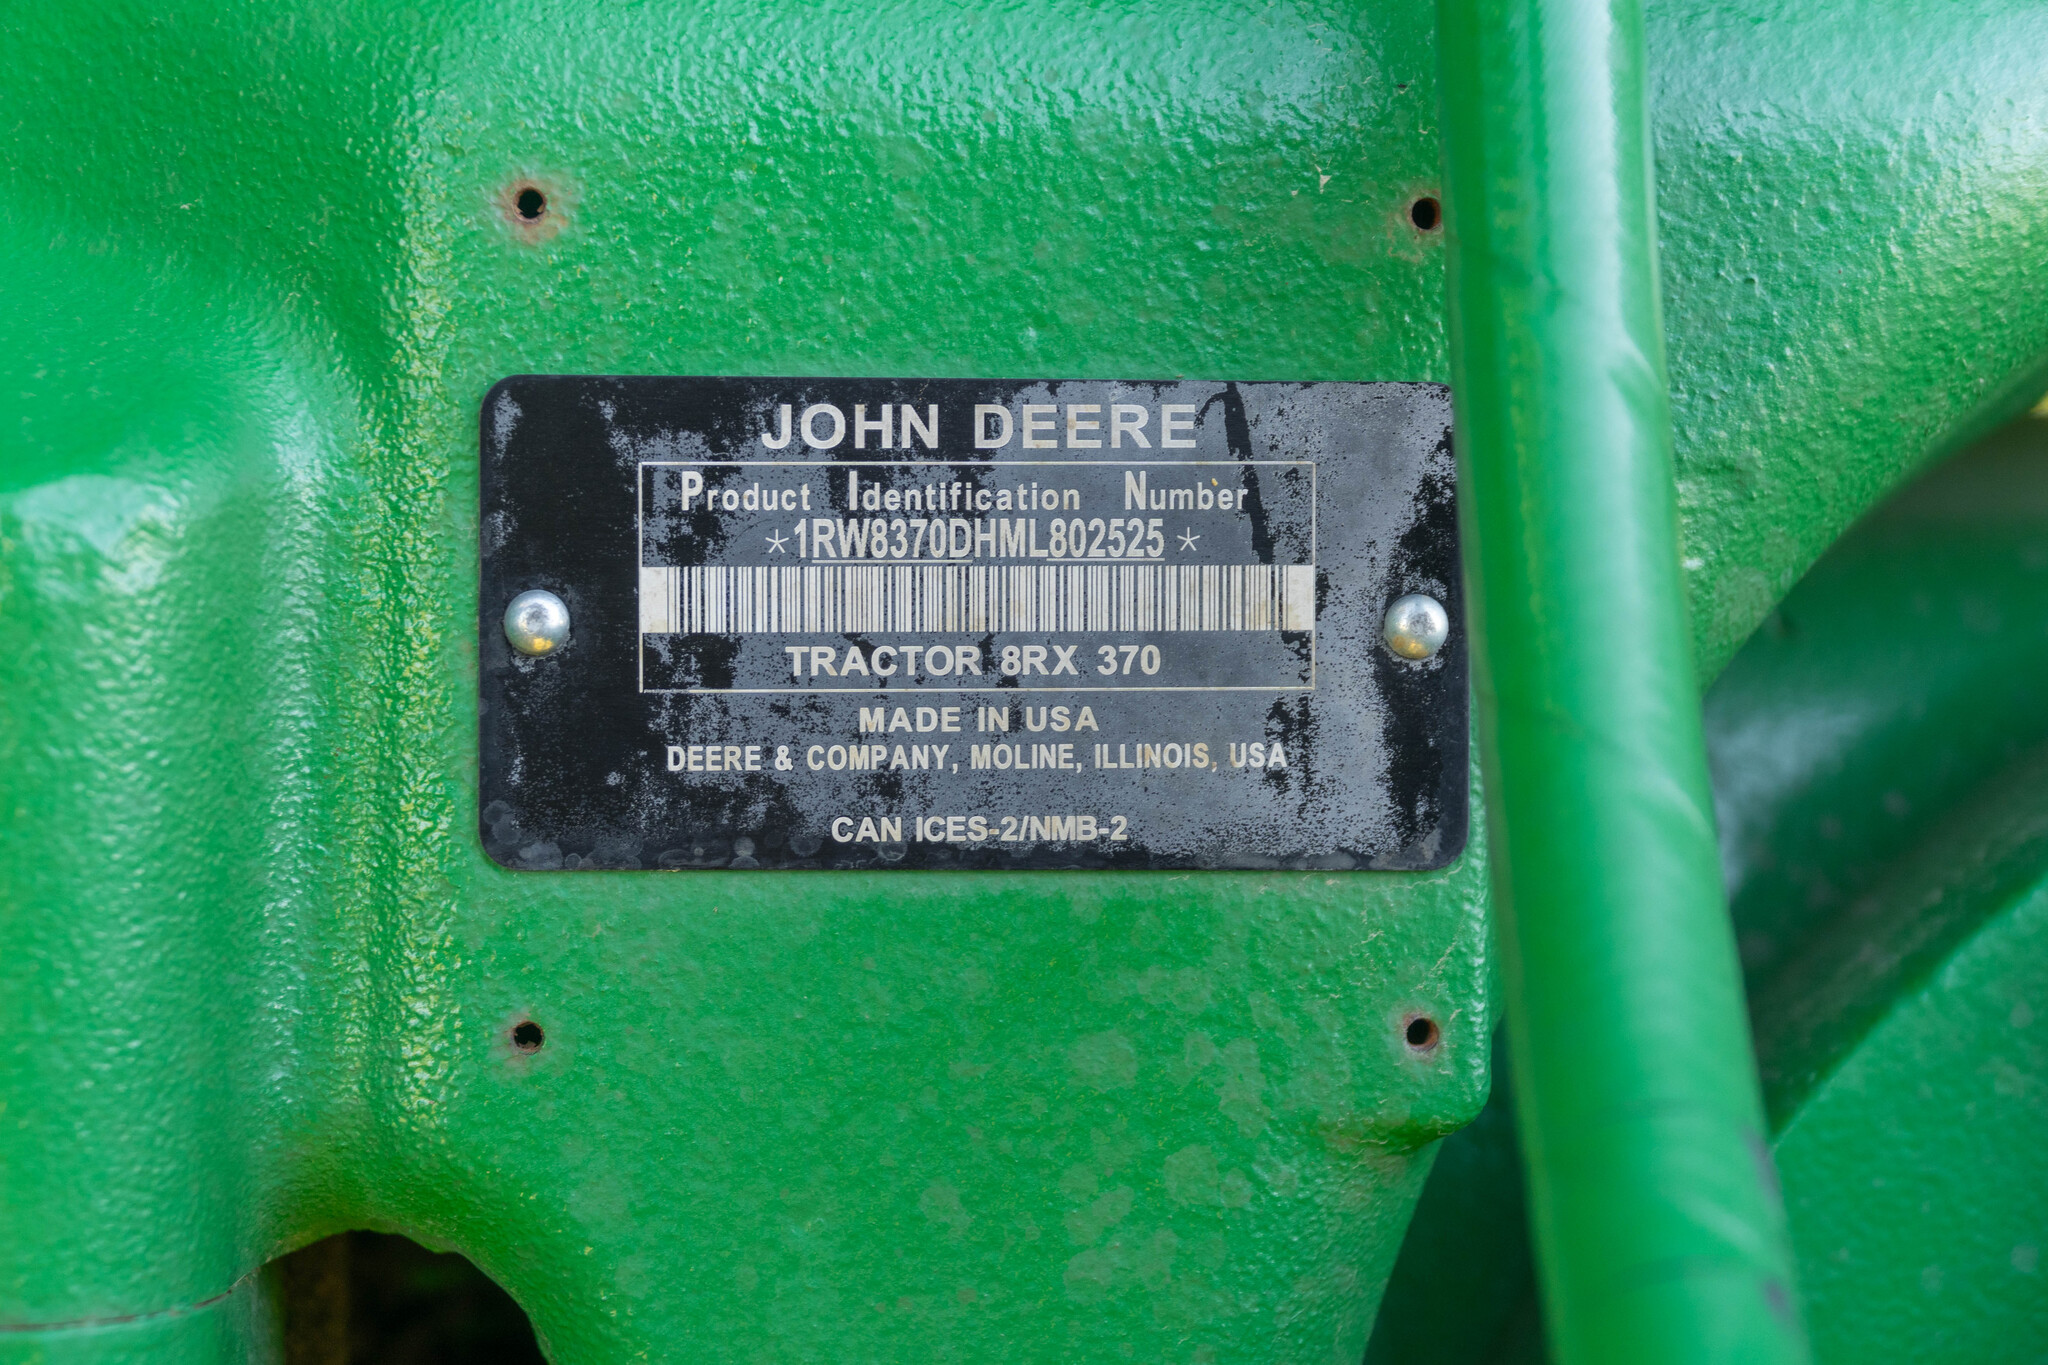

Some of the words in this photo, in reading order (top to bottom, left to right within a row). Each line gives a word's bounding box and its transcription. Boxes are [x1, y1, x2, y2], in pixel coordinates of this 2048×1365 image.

[761, 403, 939, 449] JOHN
[973, 403, 1197, 449] DEERE
[681, 470, 811, 512] Product
[848, 470, 1080, 511] Identification
[1124, 470, 1249, 510] Number
[785, 645, 982, 676] TRACTOR
[1000, 645, 1079, 676] 8RX
[1097, 644, 1161, 675] 370
[859, 706, 961, 732] MADE
[978, 706, 1009, 732] IN
[1025, 706, 1099, 732] USA
[667, 745, 761, 771] DEERE
[774, 744, 794, 771] &
[806, 744, 959, 774] COMPANY,
[971, 743, 1082, 773] MOLINE,
[1094, 742, 1217, 772] ILLINOIS,
[1230, 742, 1288, 768] USA
[831, 816, 902, 842] CAN
[916, 815, 1129, 842] ICES-2/NMB-2
